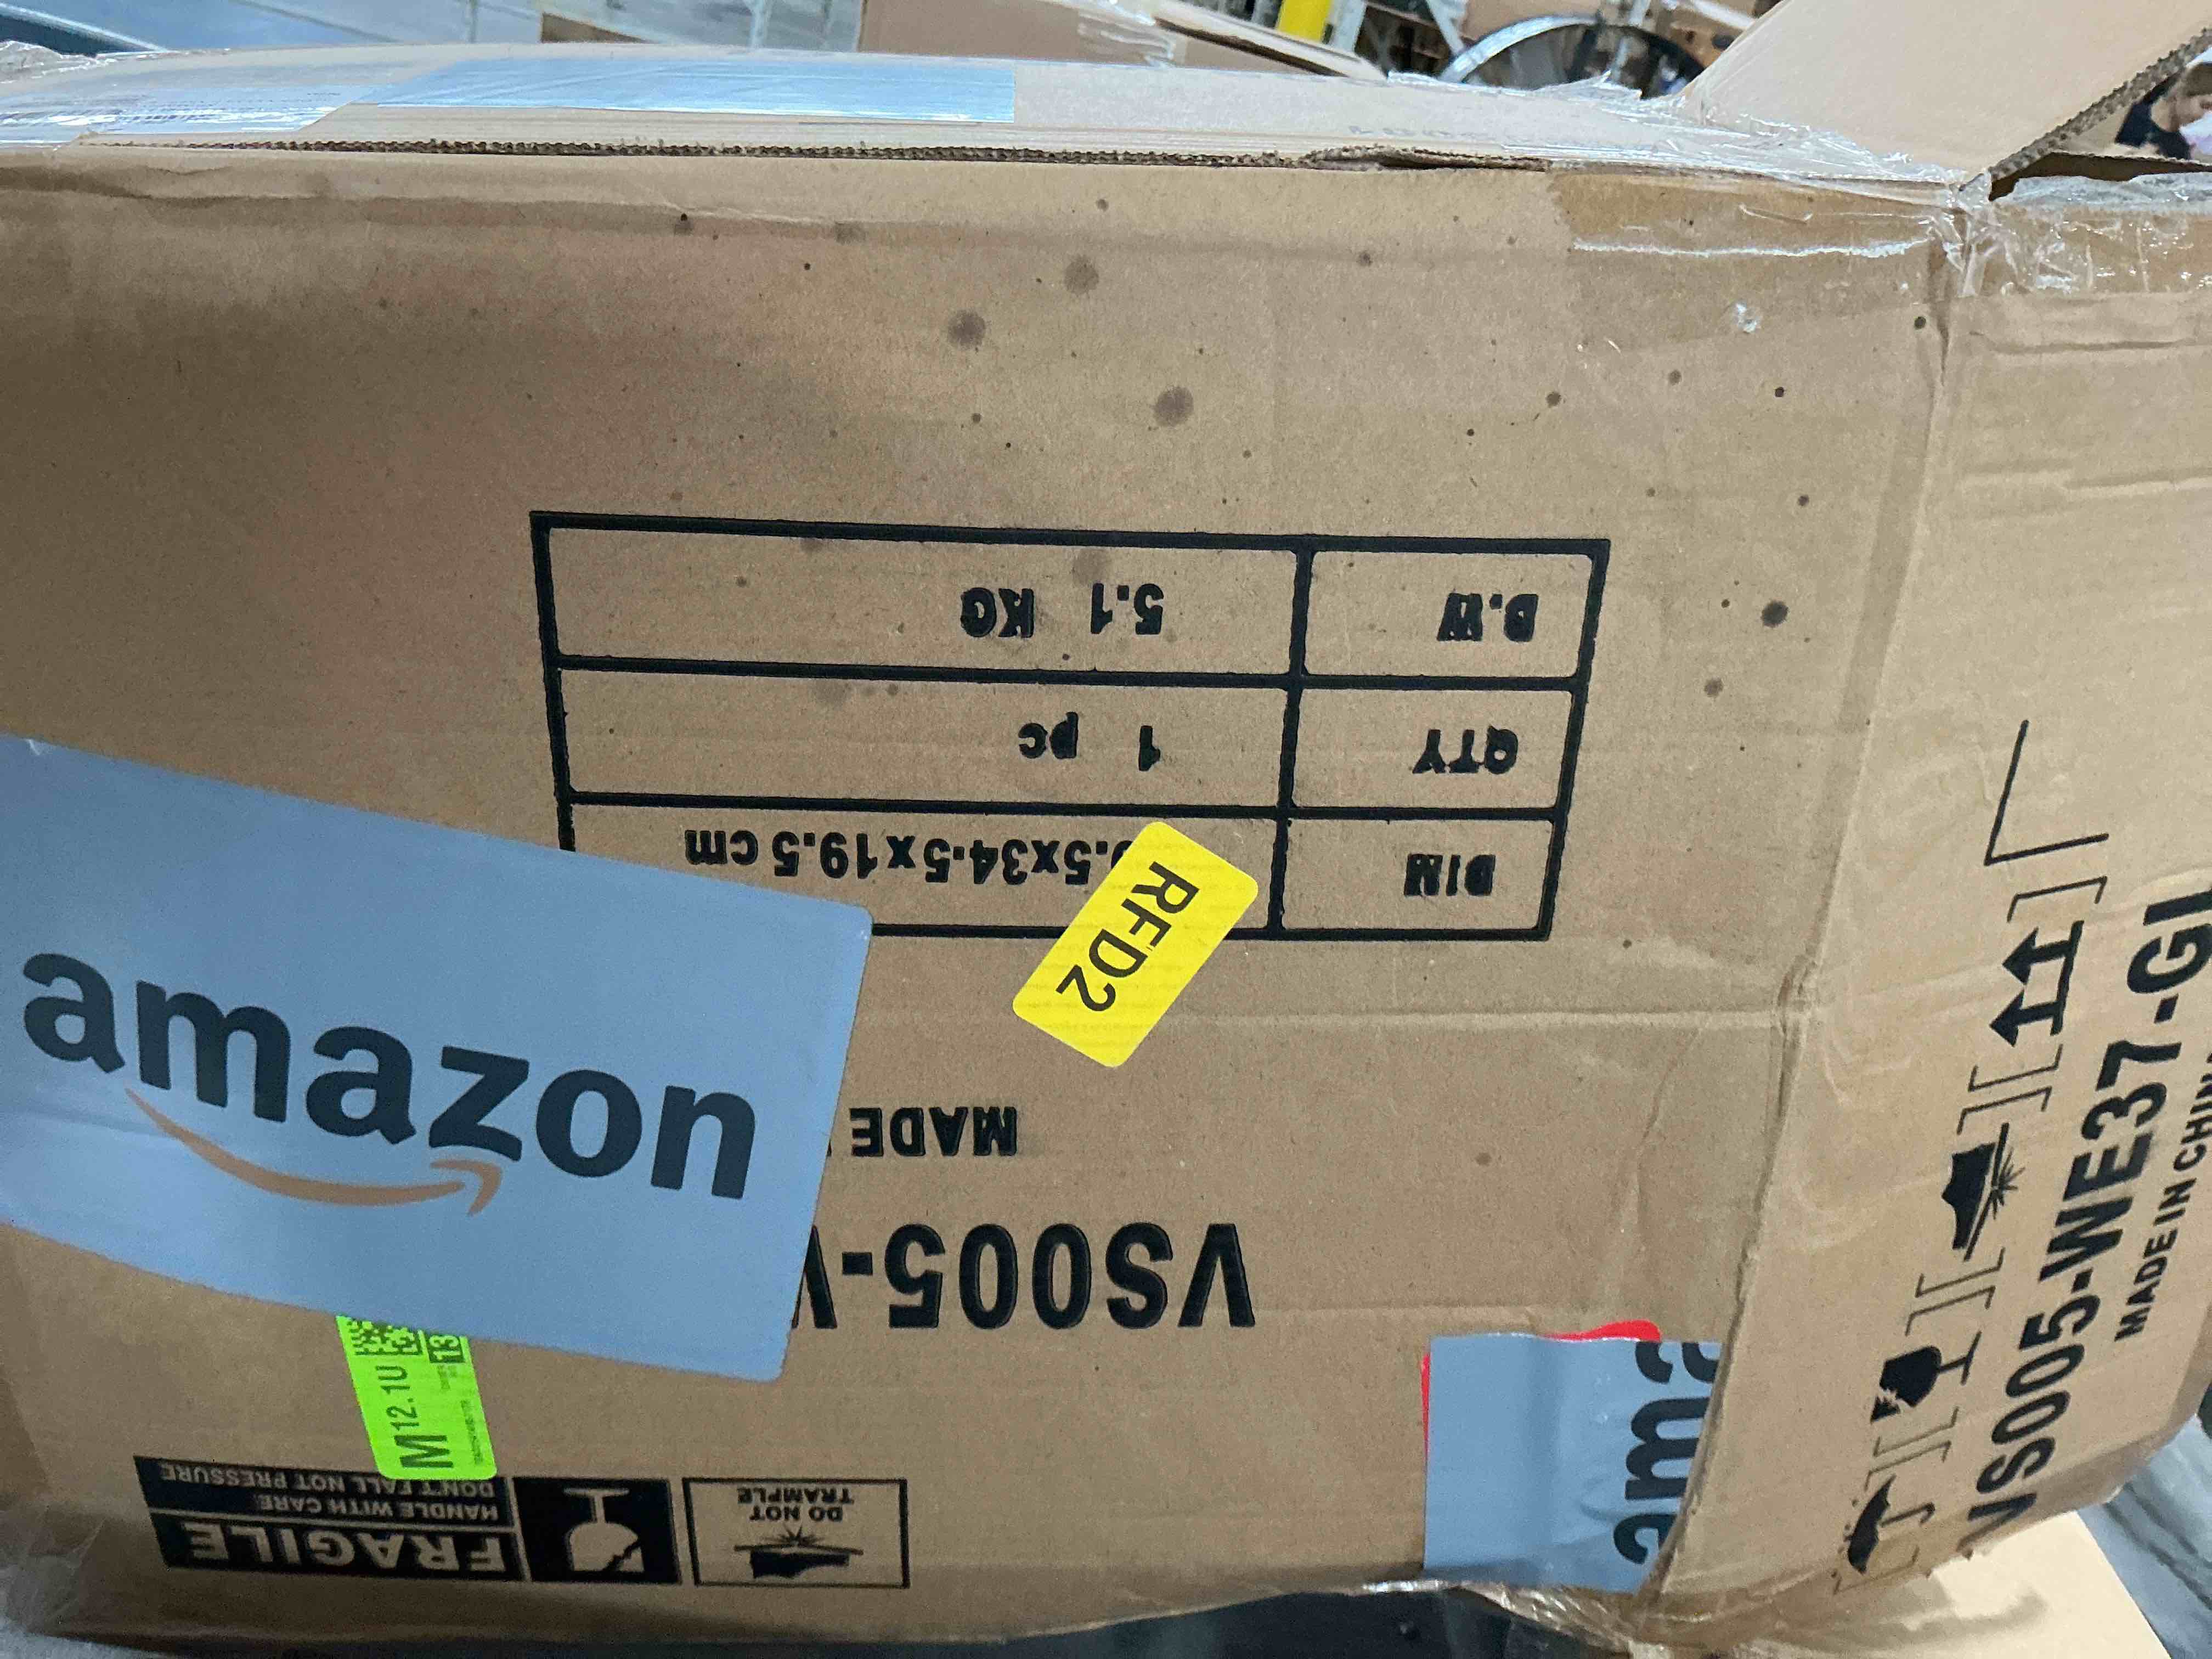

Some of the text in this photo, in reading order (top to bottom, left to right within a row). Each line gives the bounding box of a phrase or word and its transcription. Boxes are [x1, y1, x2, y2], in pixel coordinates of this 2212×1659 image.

[960, 583, 1164, 638] 5.1 KG
[1018, 712, 1161, 771] 1 pc
[1412, 725, 1519, 775] QTY
[684, 830, 759, 866] cm
[1403, 853, 1497, 896] DIM
[1055, 861, 1200, 1012] RFD2
[22, 952, 756, 1200] amazon
[849, 1105, 1018, 1157] MADE
[2114, 1053, 2212, 1342] MADE IN CHI
[160, 1462, 286, 1489] PRESSURE
[293, 1471, 346, 1493] NOT
[351, 1476, 412, 1496] FALL
[736, 1487, 855, 1505] TRAMPLE
[257, 1493, 499, 1521] HANDLE WITH CARE
[749, 1505, 843, 1522] DO NOT
[180, 1521, 508, 1572] FRAGILE
